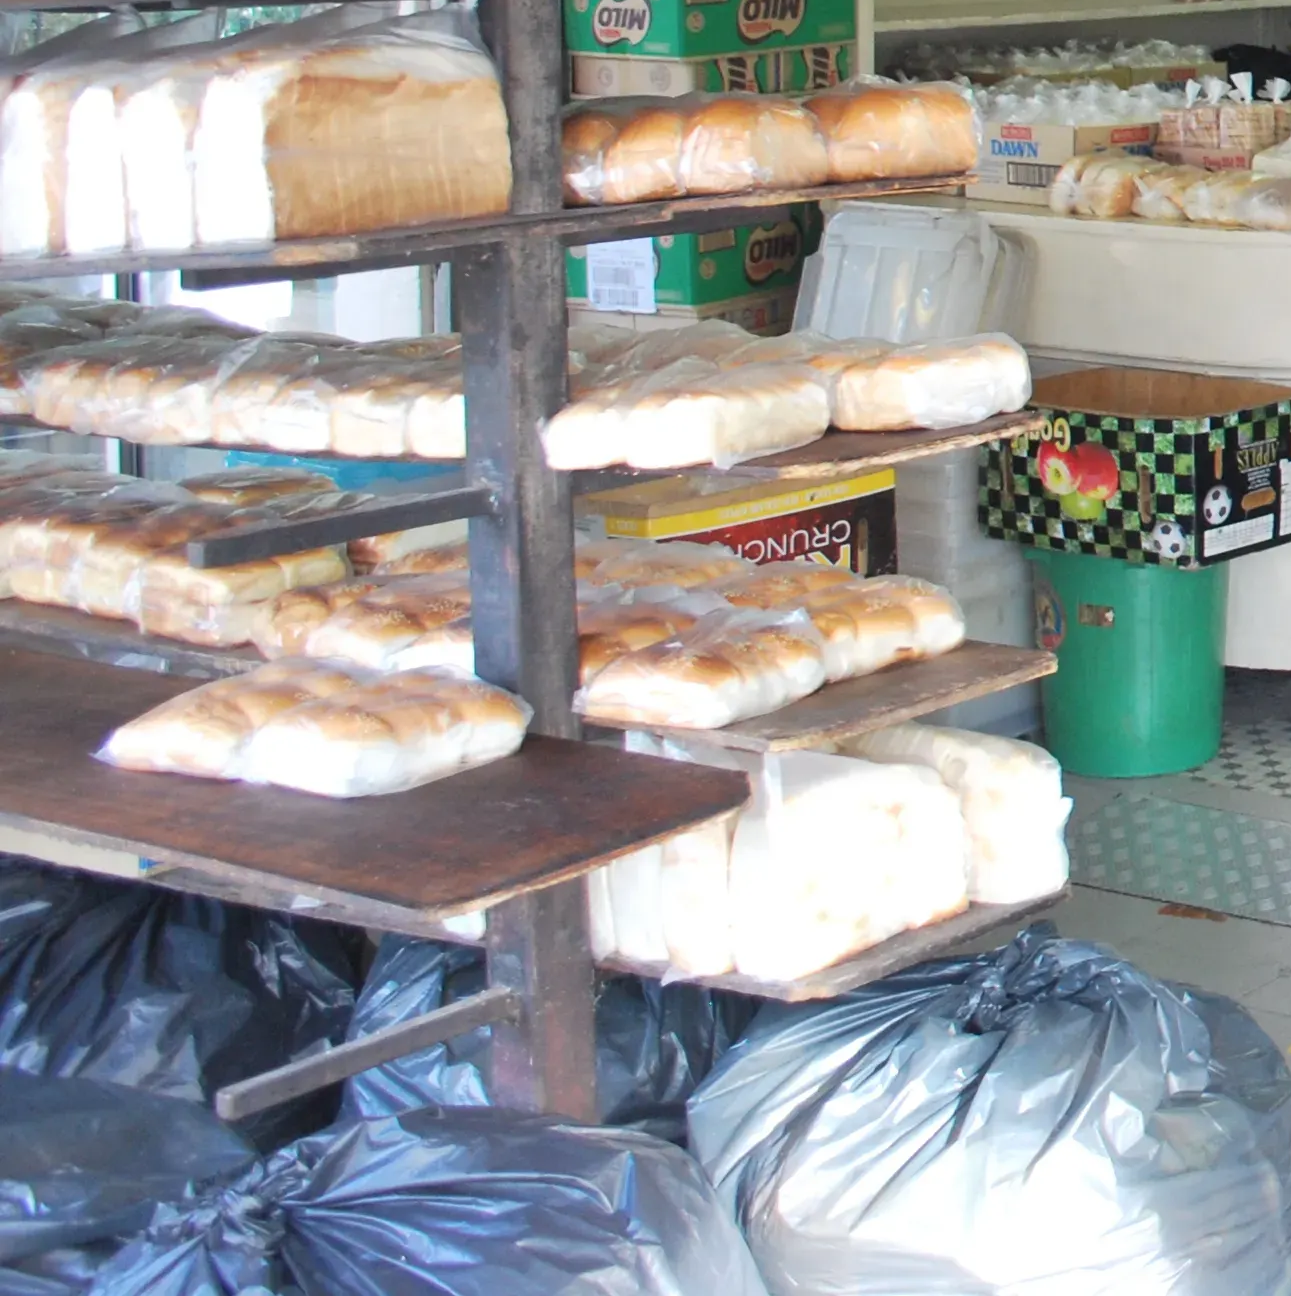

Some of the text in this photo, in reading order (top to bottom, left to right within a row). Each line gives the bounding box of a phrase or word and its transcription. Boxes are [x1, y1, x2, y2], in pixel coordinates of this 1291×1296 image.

[599, 6, 647, 30] MILO
[991, 138, 1039, 158] DAWN
[1237, 442, 1280, 470] APPLES
